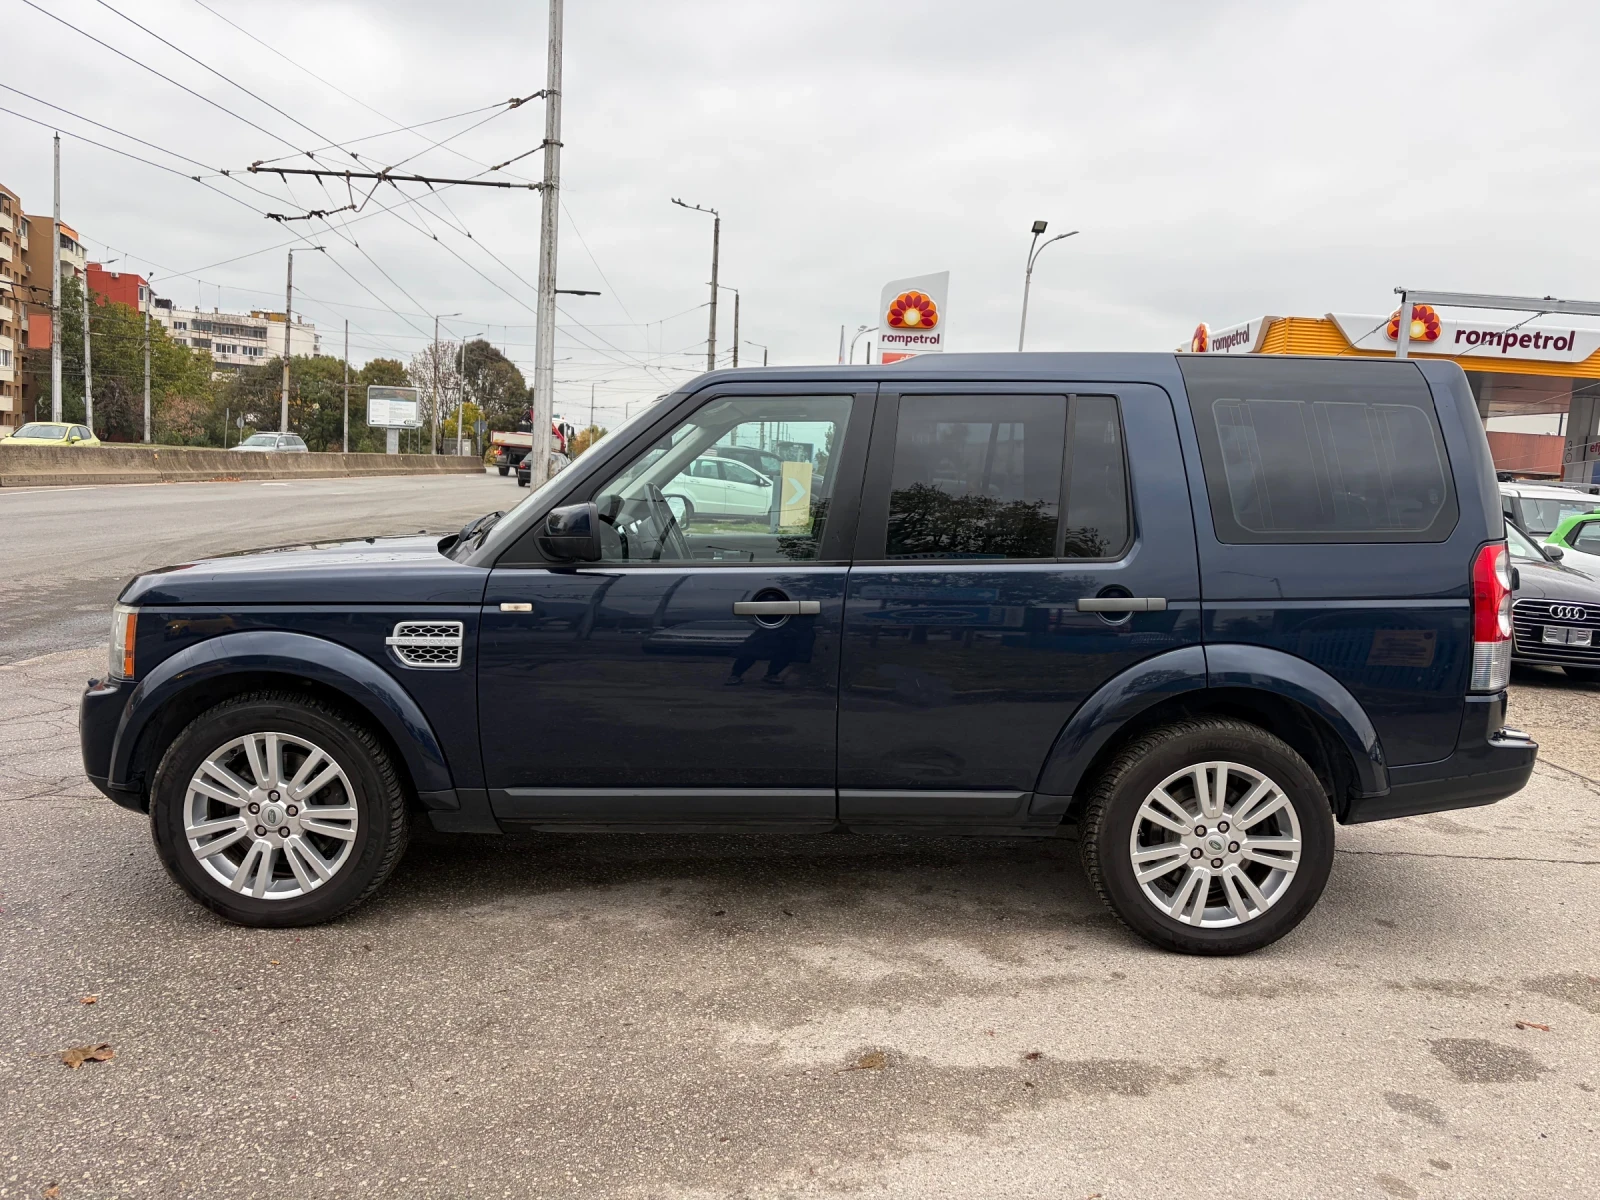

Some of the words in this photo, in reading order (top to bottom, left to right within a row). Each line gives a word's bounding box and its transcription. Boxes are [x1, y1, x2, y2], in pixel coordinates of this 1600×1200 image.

[882, 333, 940, 346] rompetrol
[1212, 323, 1250, 353] rompetrol
[1455, 330, 1576, 354] rompetrol
